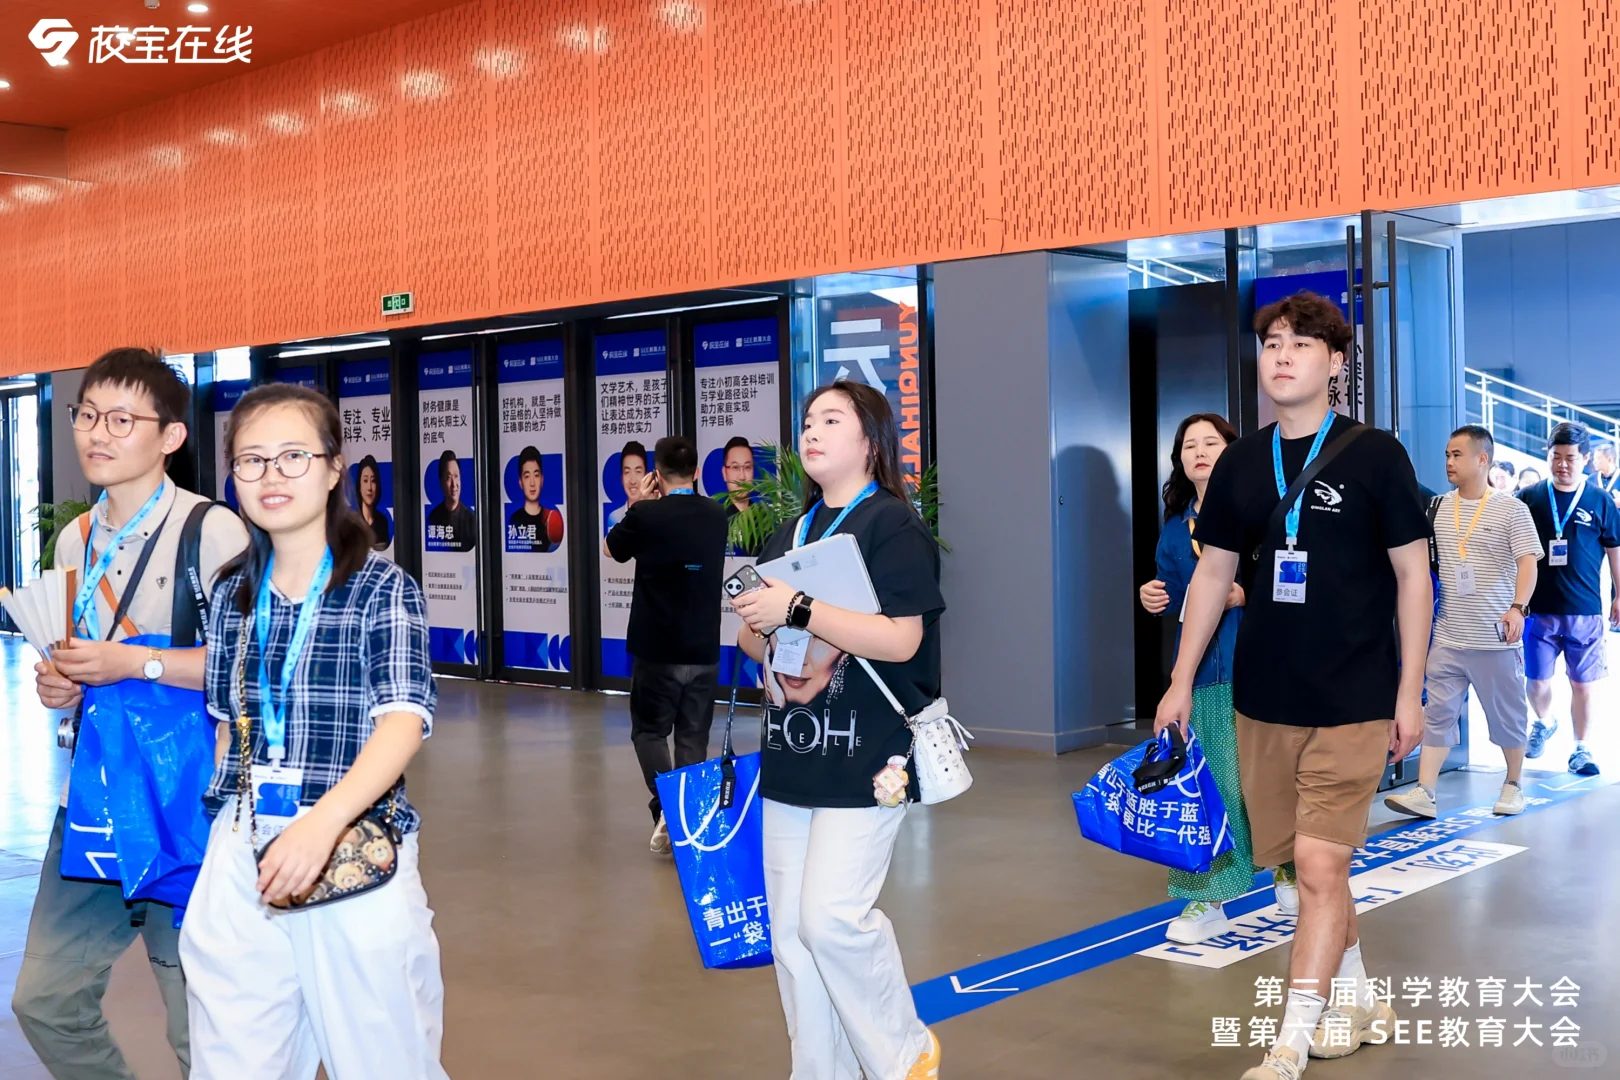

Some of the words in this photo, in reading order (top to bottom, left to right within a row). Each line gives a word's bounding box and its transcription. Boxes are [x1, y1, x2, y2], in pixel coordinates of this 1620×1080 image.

[700, 373, 775, 388] 专注小初高全科培训
[700, 387, 758, 402] 与学业路径设计
[423, 399, 459, 413] 财务健康是
[601, 406, 661, 421] 让表达成为孩子
[700, 401, 750, 415] 助力家庭实现
[343, 406, 390, 425] 专注、专业
[423, 414, 467, 429] 机构长期主义
[502, 406, 562, 422] 好品格的人坚持做
[701, 415, 734, 427] 升学目标
[343, 424, 391, 443] 科学、乐学
[502, 420, 546, 433] 正确事的地方
[601, 421, 652, 435] 终身的软实力
[423, 431, 446, 444] 的底气
[428, 525, 454, 540] 谭海忠
[508, 525, 537, 540] 孙立君
[703, 895, 767, 932] 青出于
